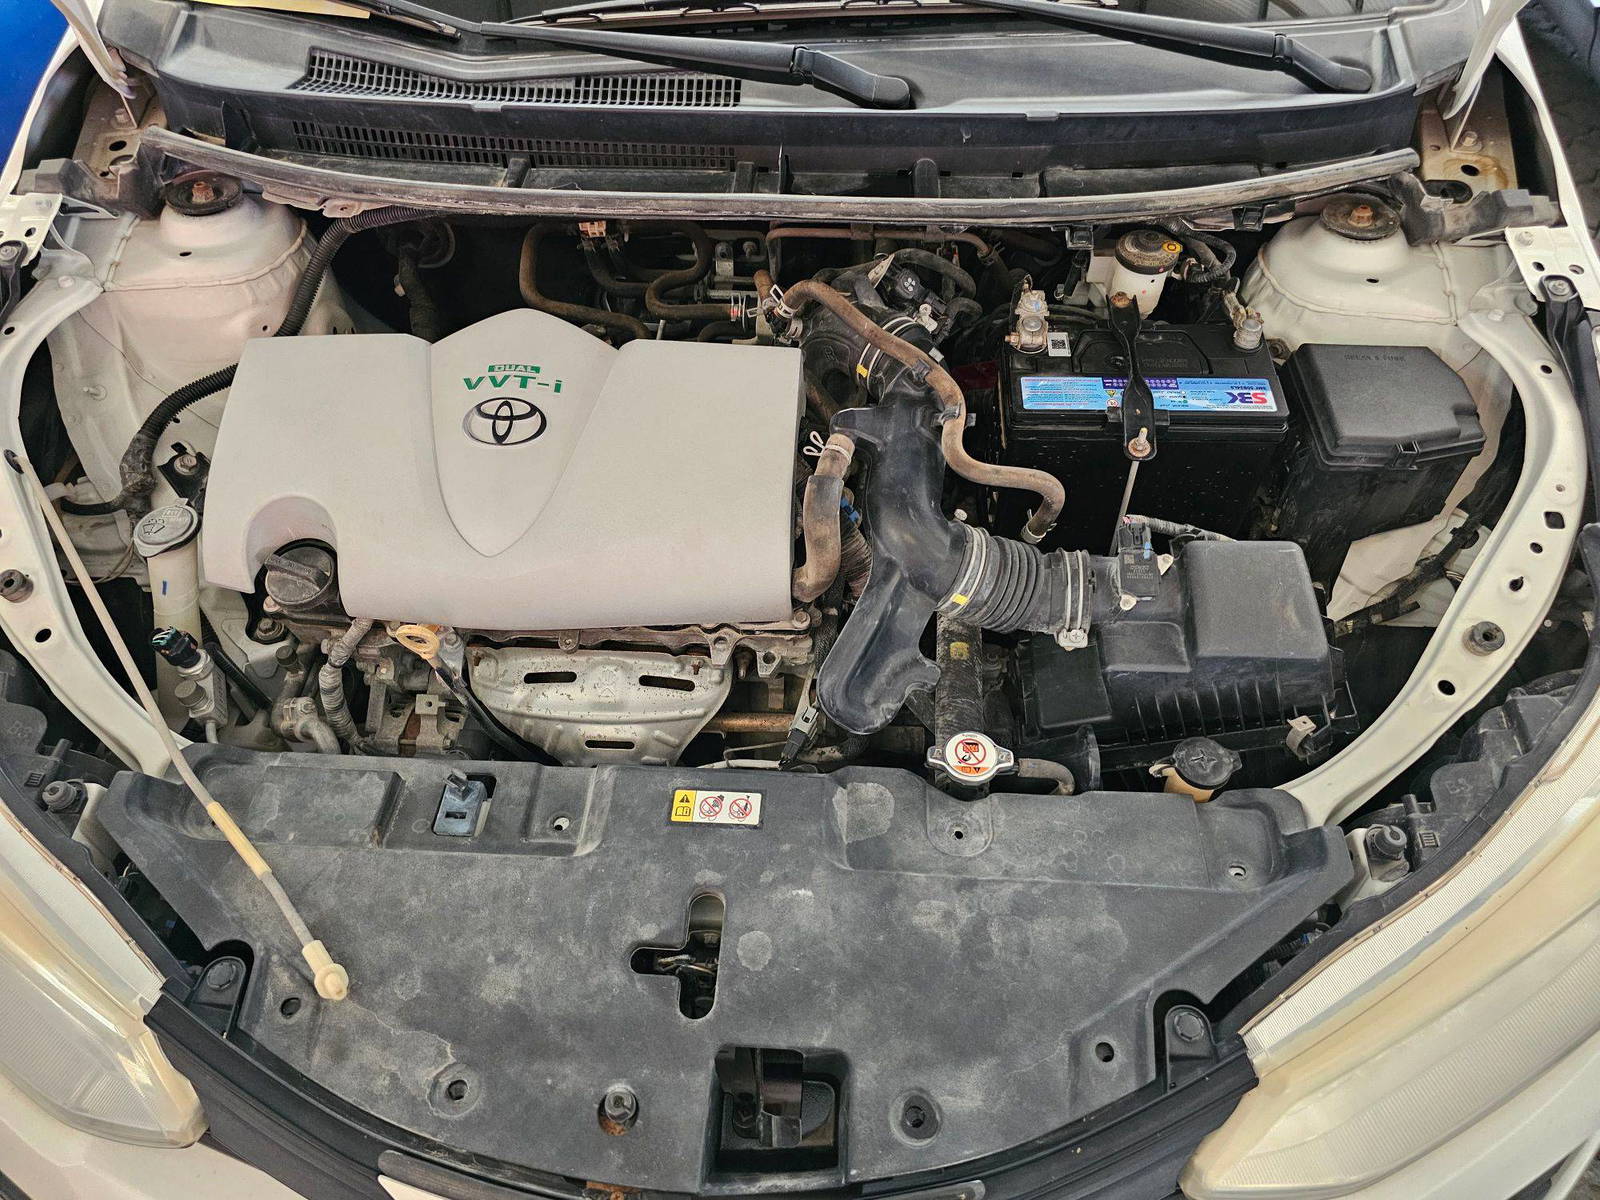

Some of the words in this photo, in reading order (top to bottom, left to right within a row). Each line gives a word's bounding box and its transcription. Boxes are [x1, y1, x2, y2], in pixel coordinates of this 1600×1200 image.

[492, 364, 537, 374] DUAL
[463, 374, 563, 393] VVT-i
[1224, 391, 1268, 405] SBK
